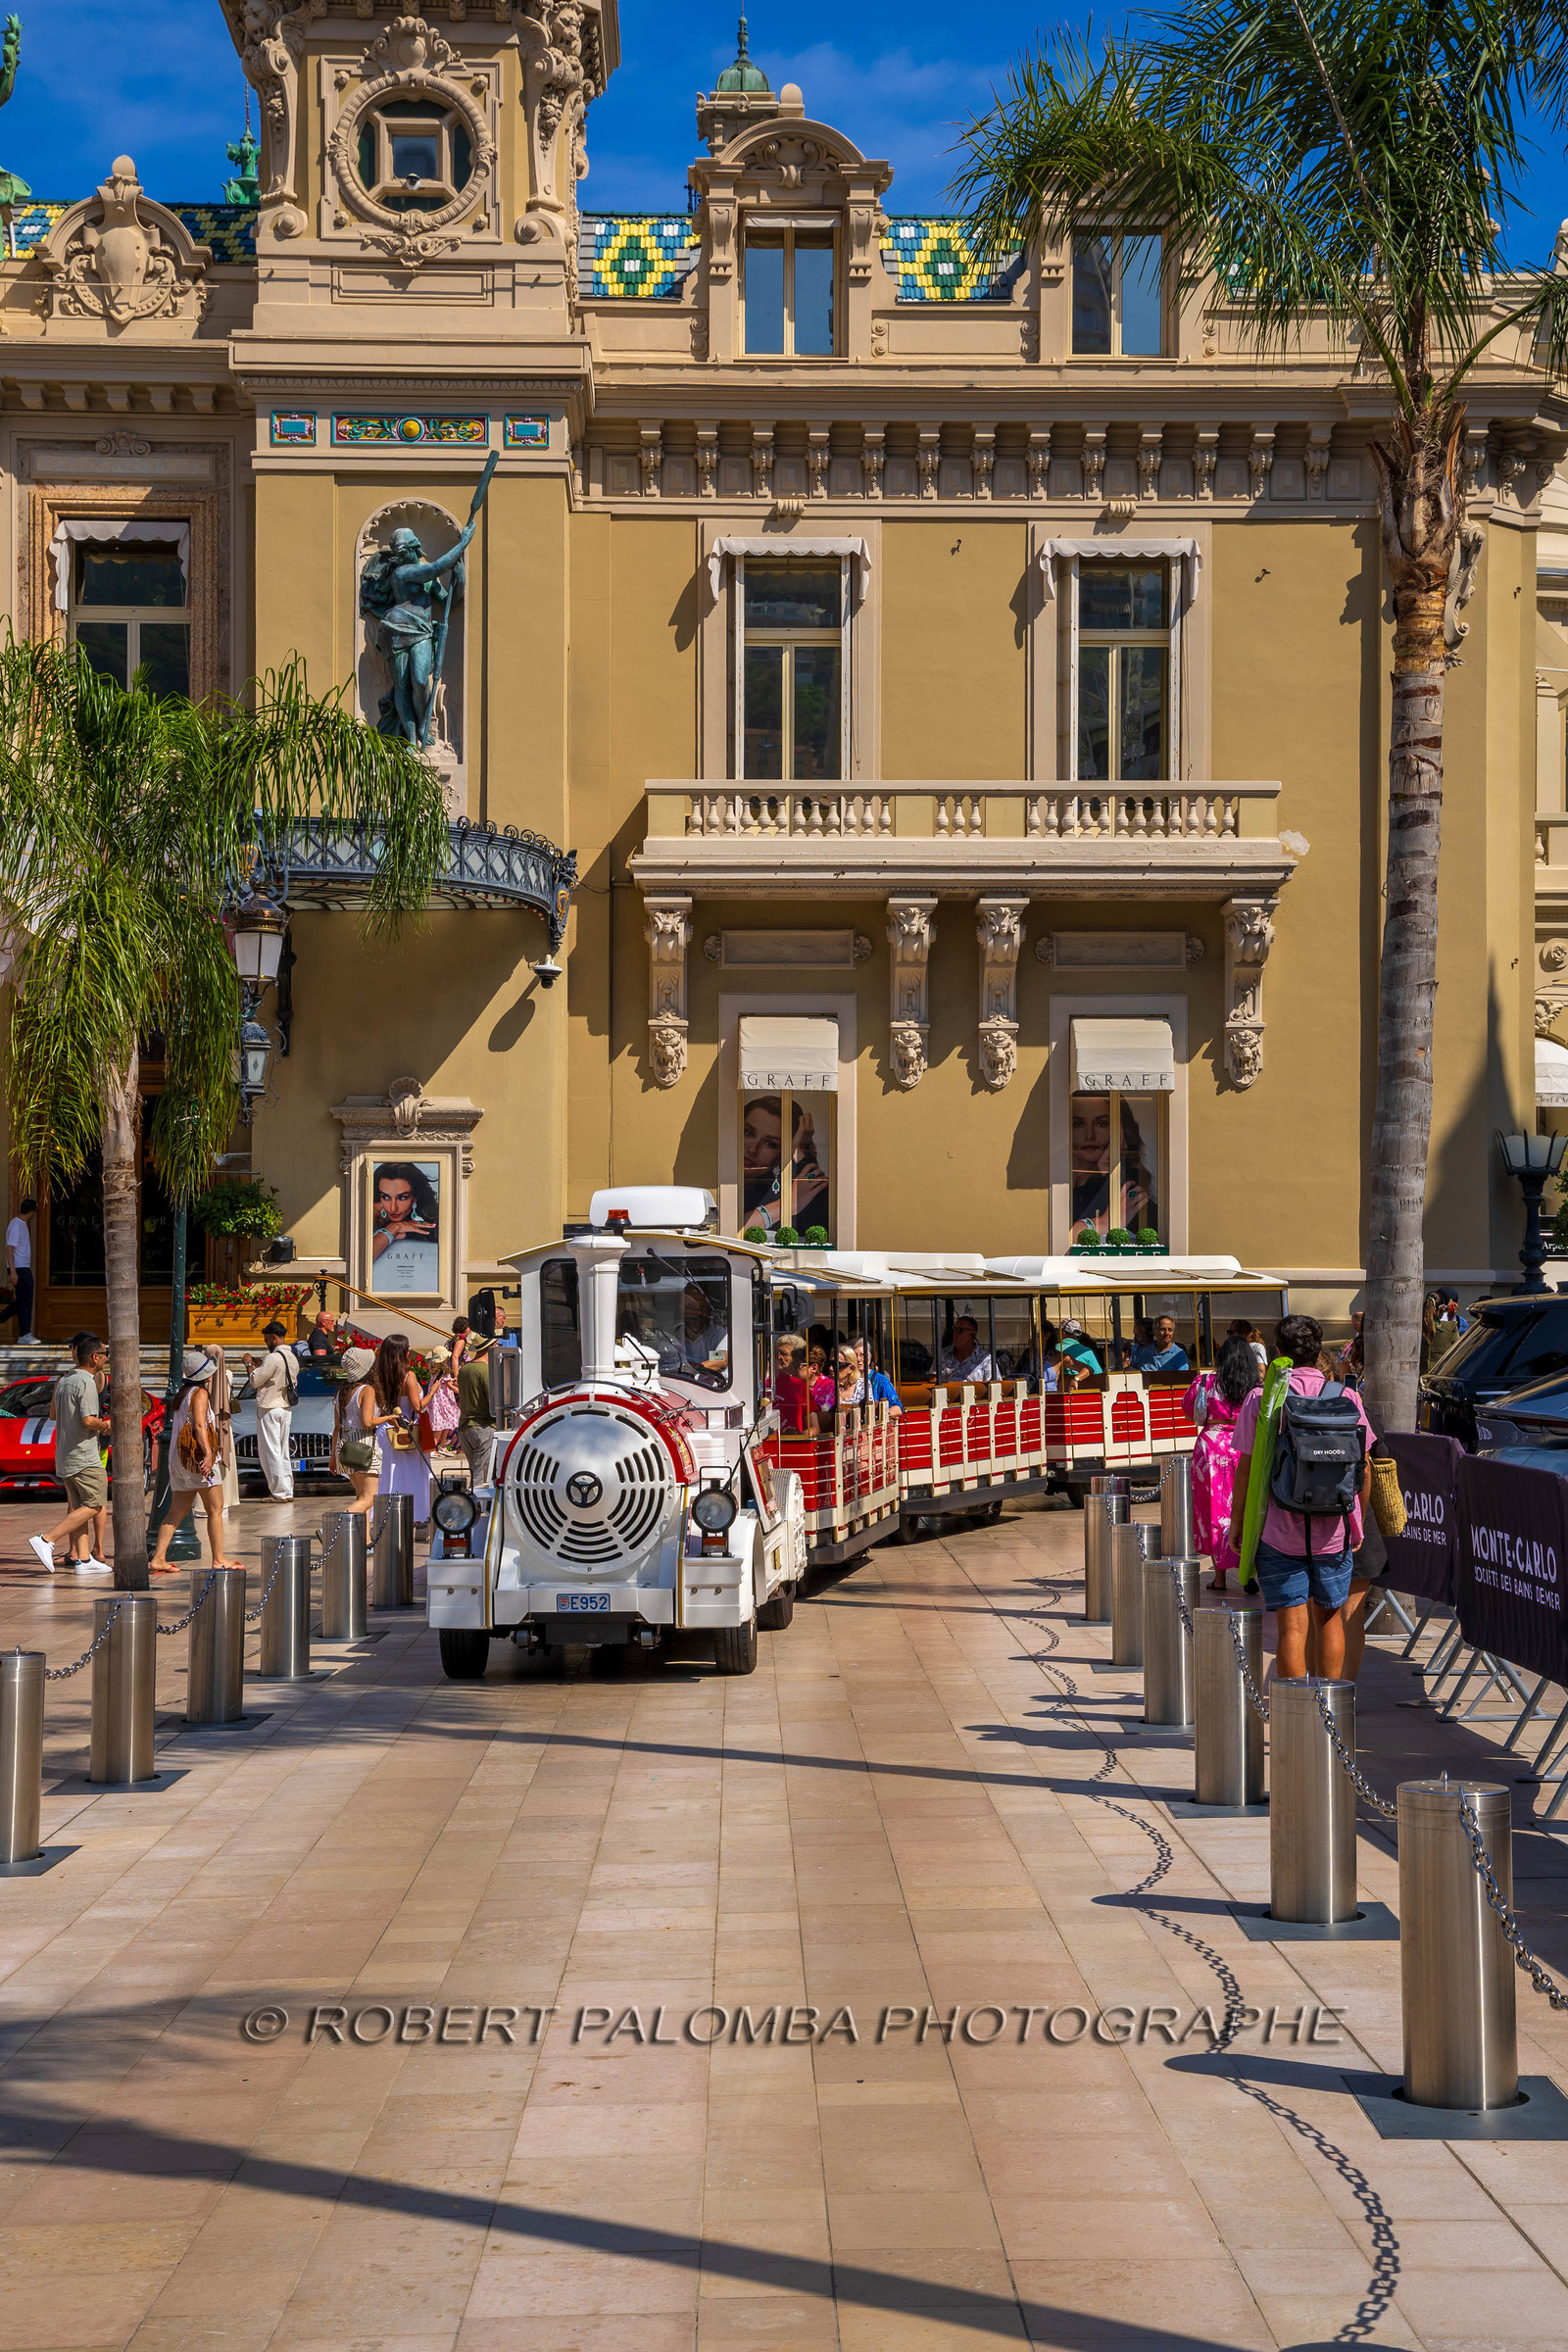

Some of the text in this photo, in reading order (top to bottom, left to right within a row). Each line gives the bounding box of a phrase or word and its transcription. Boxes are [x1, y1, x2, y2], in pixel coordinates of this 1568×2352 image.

[747, 1073, 830, 1087] GRAFF
[1085, 1074, 1167, 1087] GRAFF
[56, 1215, 99, 1226] GRAF
[1423, 1528, 1432, 1543] DE
[1433, 1530, 1447, 1546] MER
[570, 1595, 608, 1610] E952
